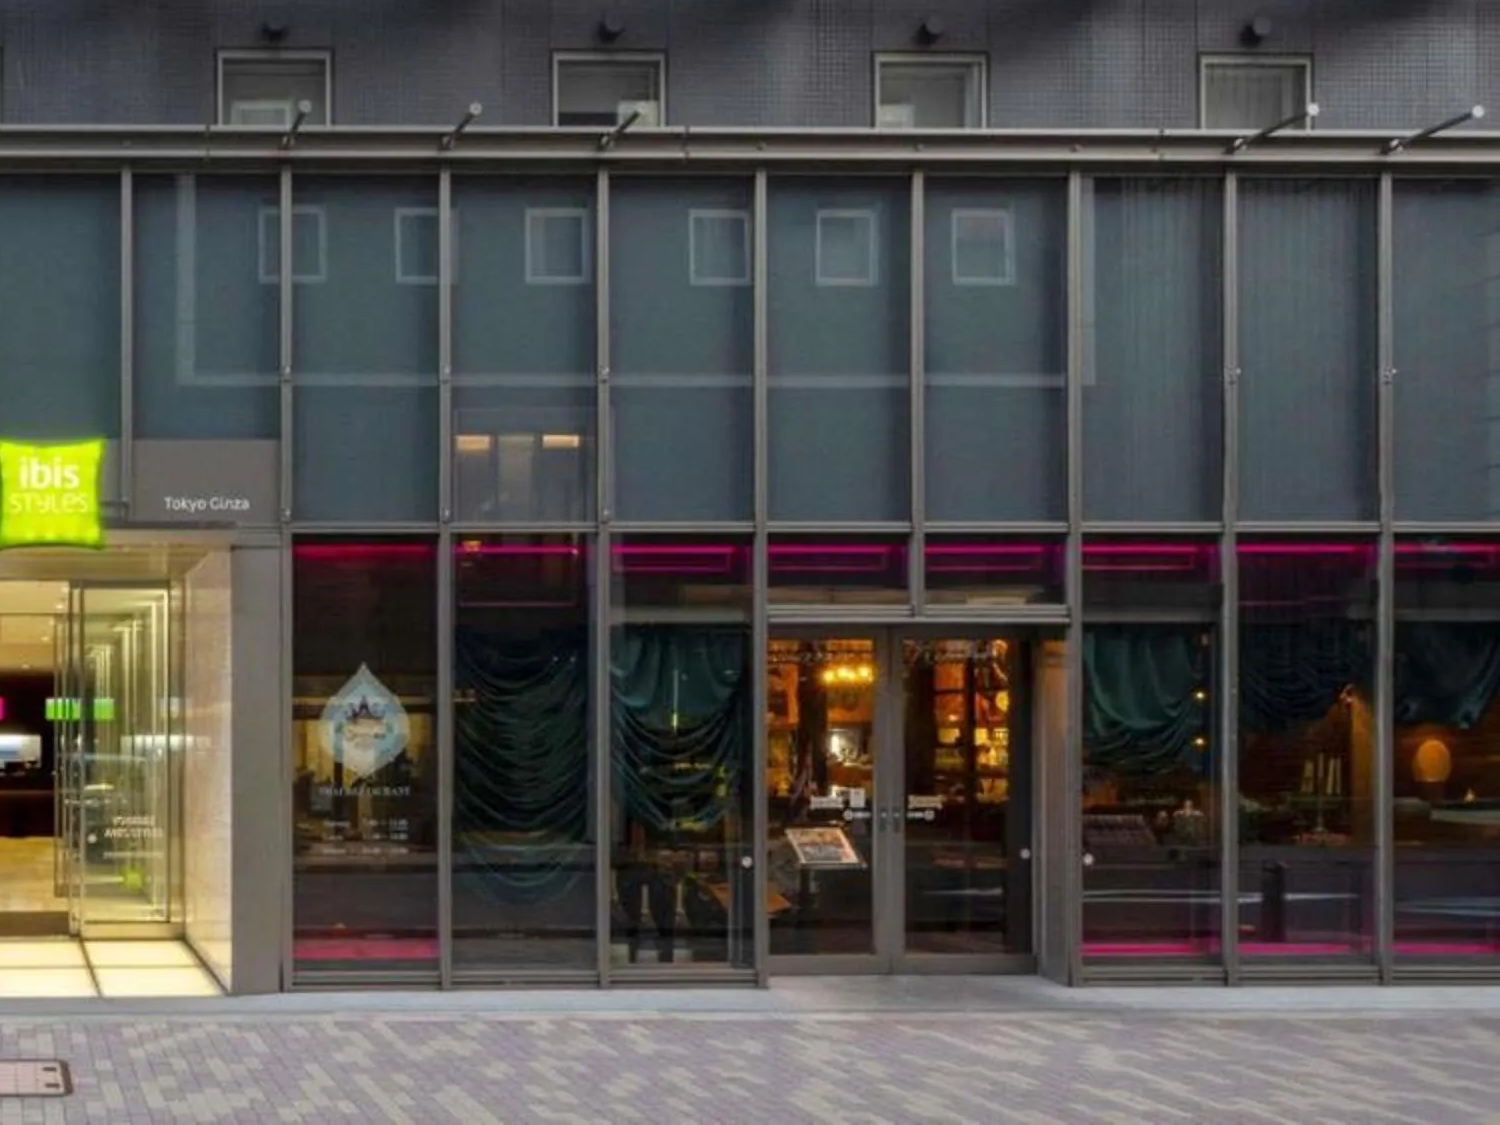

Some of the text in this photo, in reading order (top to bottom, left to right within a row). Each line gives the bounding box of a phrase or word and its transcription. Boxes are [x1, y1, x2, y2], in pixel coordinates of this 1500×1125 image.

[18, 455, 81, 490] ibis
[163, 495, 250, 514] Tokyo Ginza
